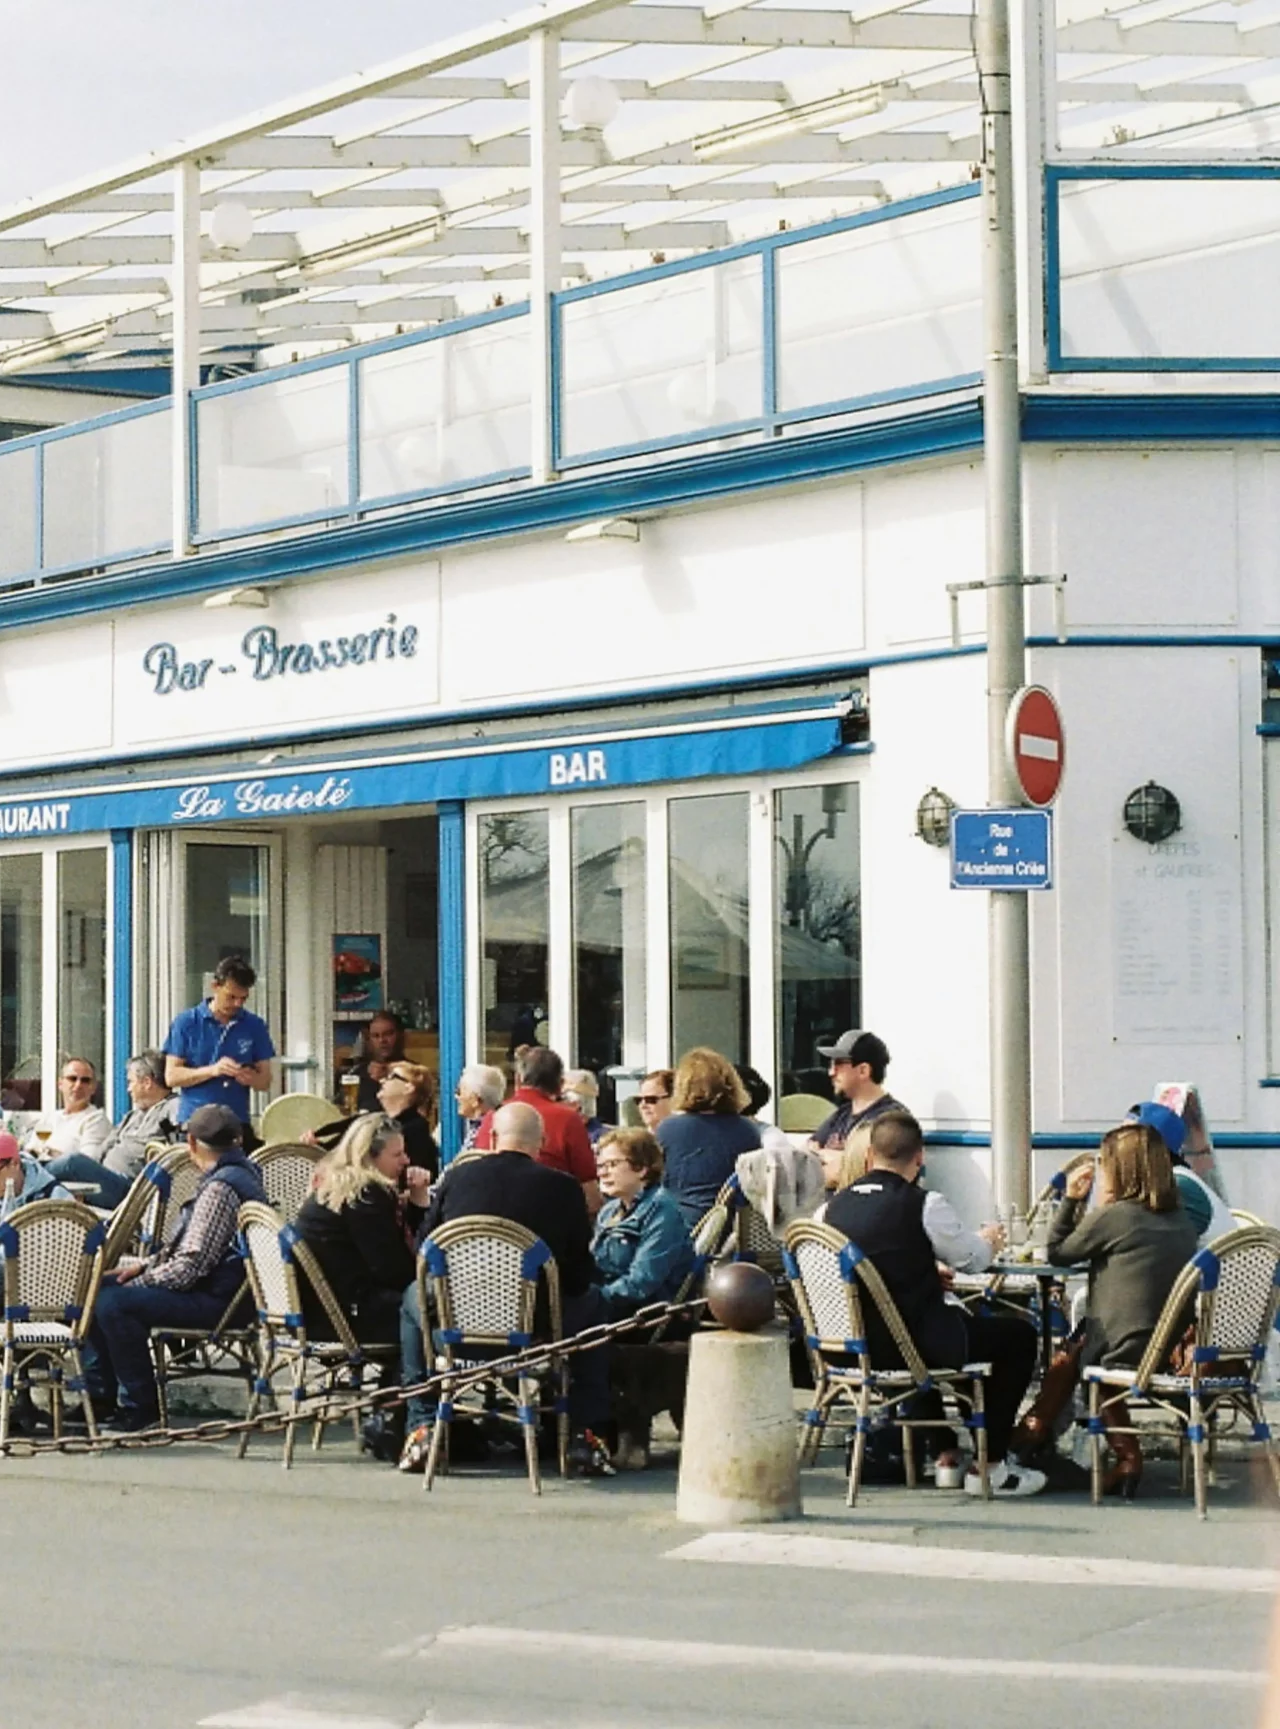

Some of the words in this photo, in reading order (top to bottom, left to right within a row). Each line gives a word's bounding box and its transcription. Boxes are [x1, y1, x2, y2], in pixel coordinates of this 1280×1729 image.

[144, 641, 213, 694] Bar
[241, 612, 418, 680] Brasserie
[550, 750, 607, 785] BAR
[172, 786, 225, 819] La
[235, 777, 352, 814] Gaieté
[989, 823, 1013, 838] Rue
[993, 842, 1008, 857] de
